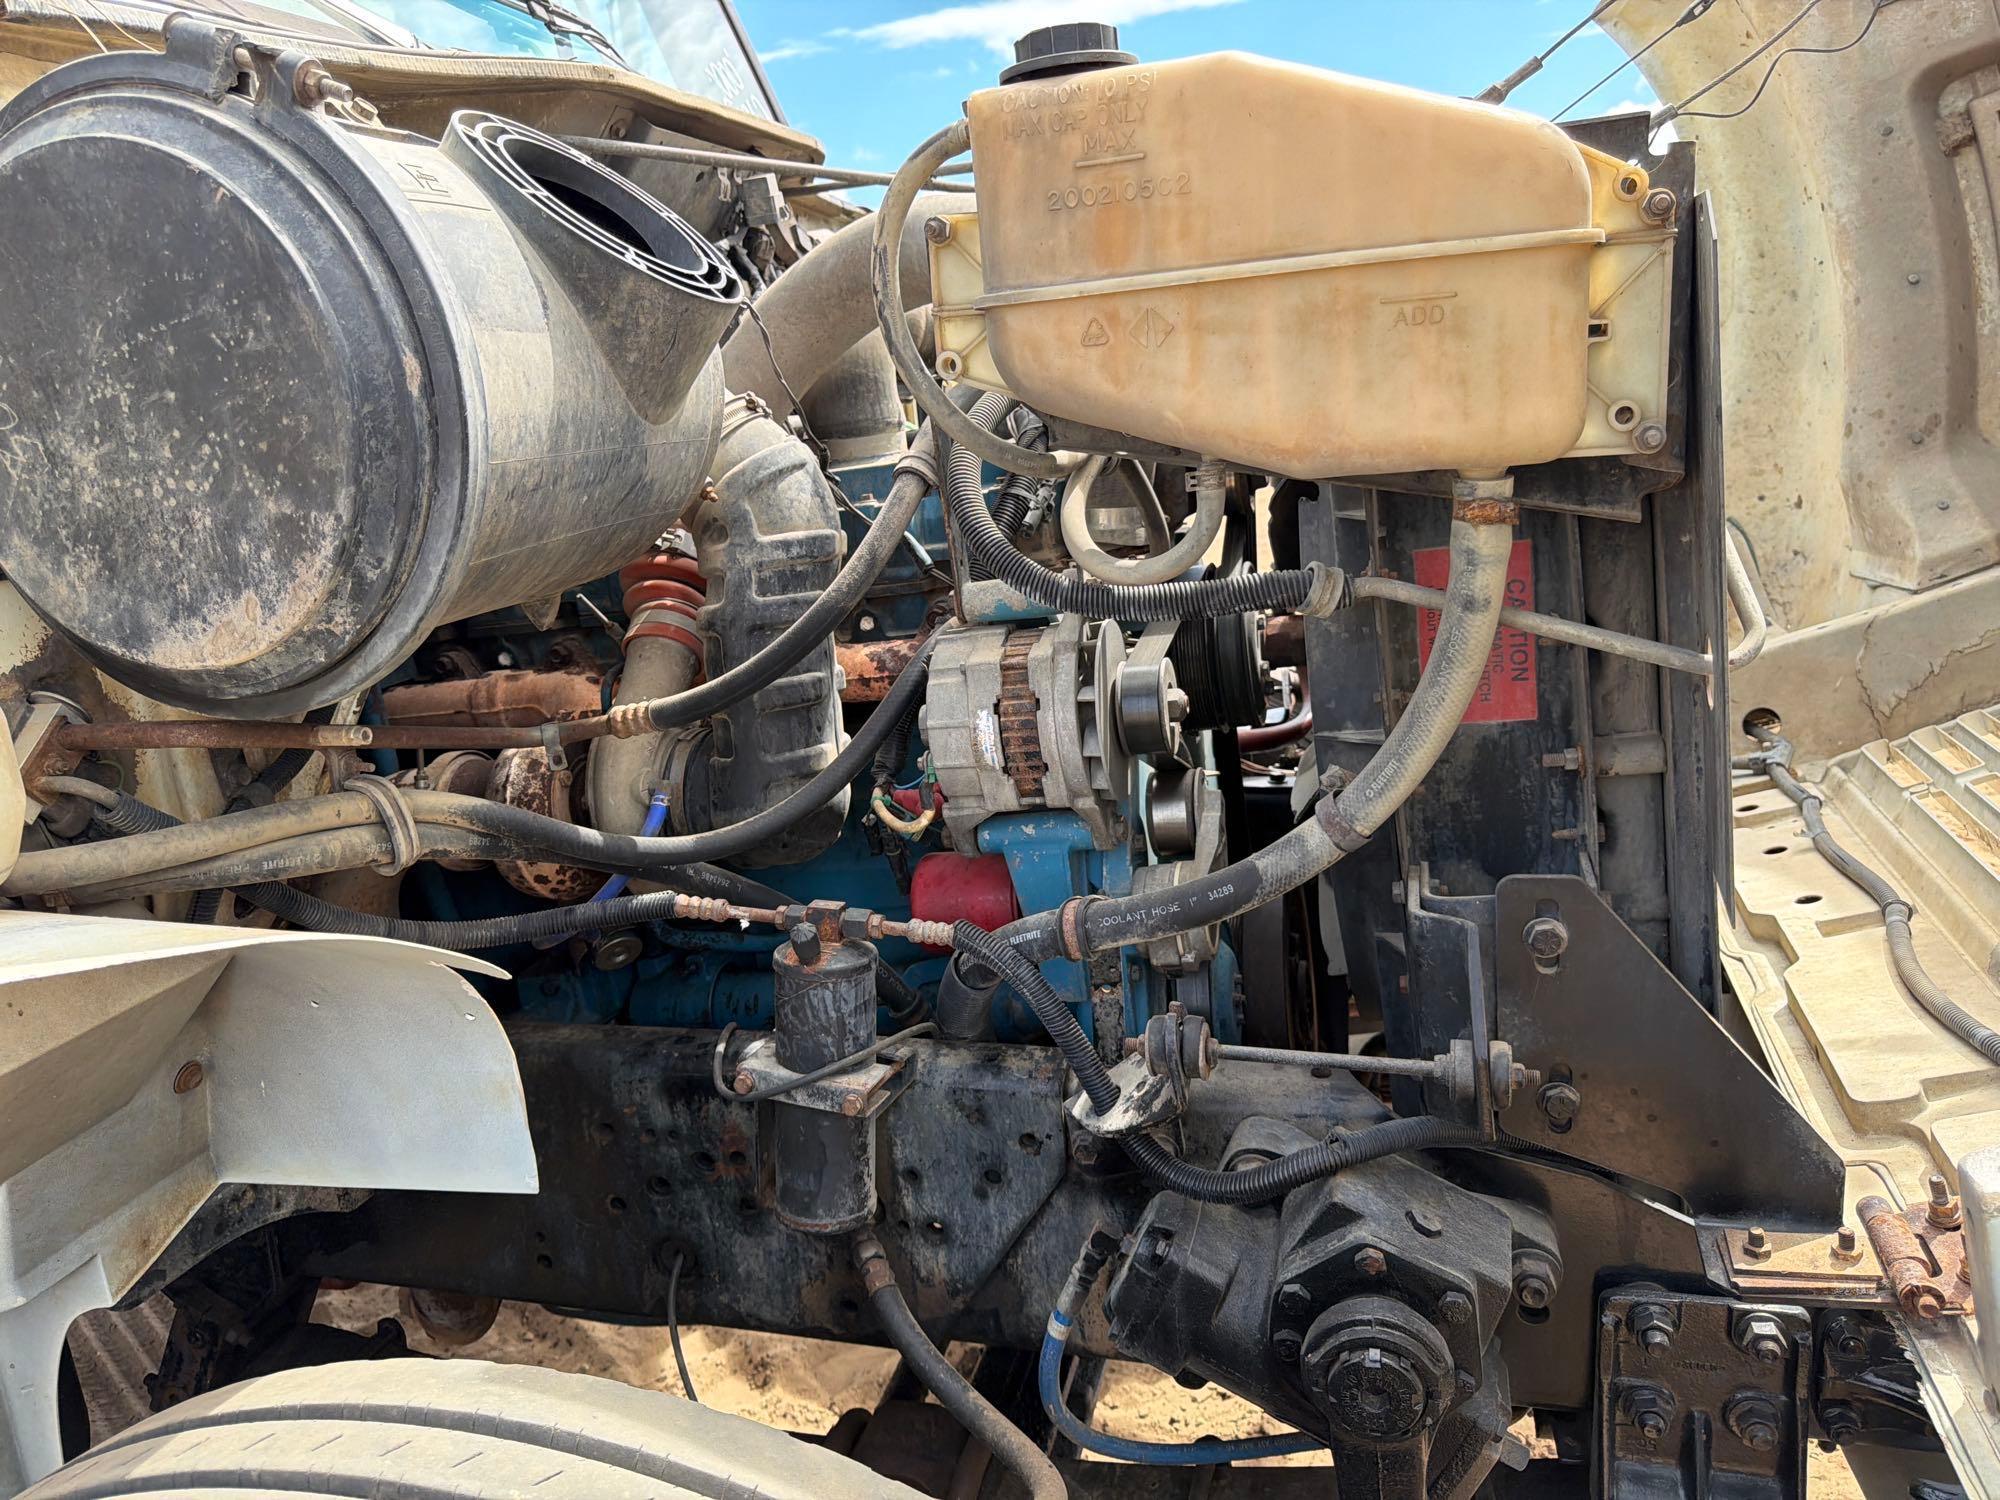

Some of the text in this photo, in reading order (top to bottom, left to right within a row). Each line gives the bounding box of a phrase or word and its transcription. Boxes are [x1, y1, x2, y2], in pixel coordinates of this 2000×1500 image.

[1083, 128, 1137, 154] MAX
[1047, 171, 1192, 212] 2002105C2
[1393, 304, 1445, 326] ADD
[1448, 627, 1463, 658] HOSE
[1506, 579, 1529, 682] CATION
[1009, 930, 1041, 946] FLEETRITE
[1098, 909, 1147, 927] COOLANT
[1151, 902, 1181, 917] HOSE
[1207, 883, 1235, 901] 34289
